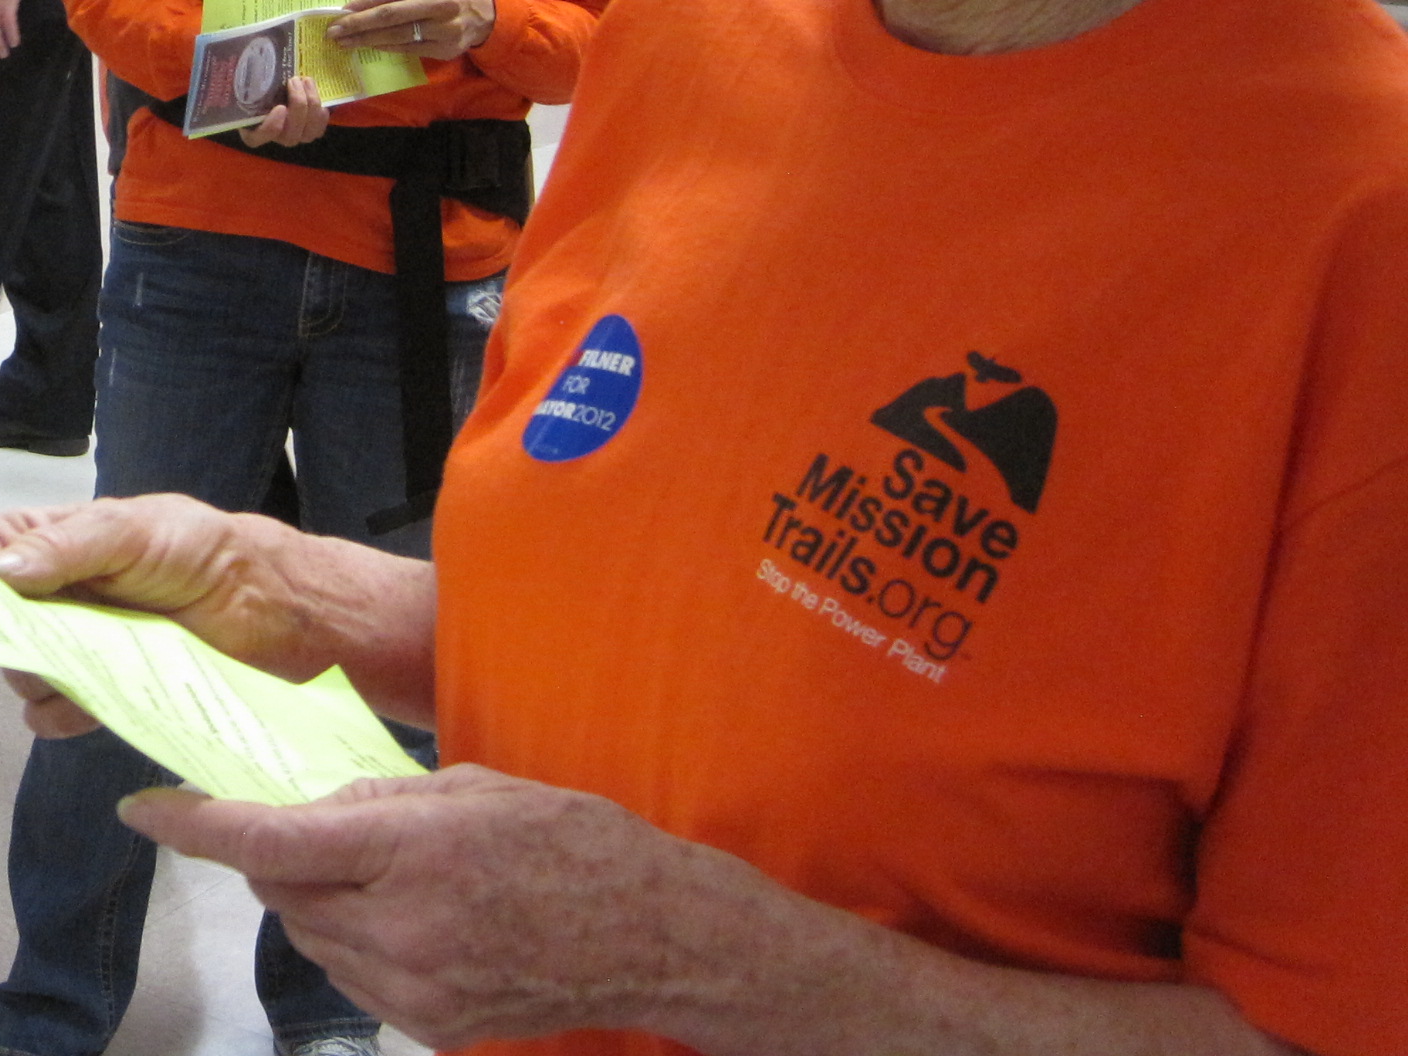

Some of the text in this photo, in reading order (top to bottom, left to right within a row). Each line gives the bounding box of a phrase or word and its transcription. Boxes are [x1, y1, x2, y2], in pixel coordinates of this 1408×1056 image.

[562, 375, 590, 395] FOR
[795, 452, 1000, 604] Mission
[883, 448, 1019, 559] Save
[756, 558, 949, 685] Stop the Power Plant
[762, 492, 973, 660] Trails.org
